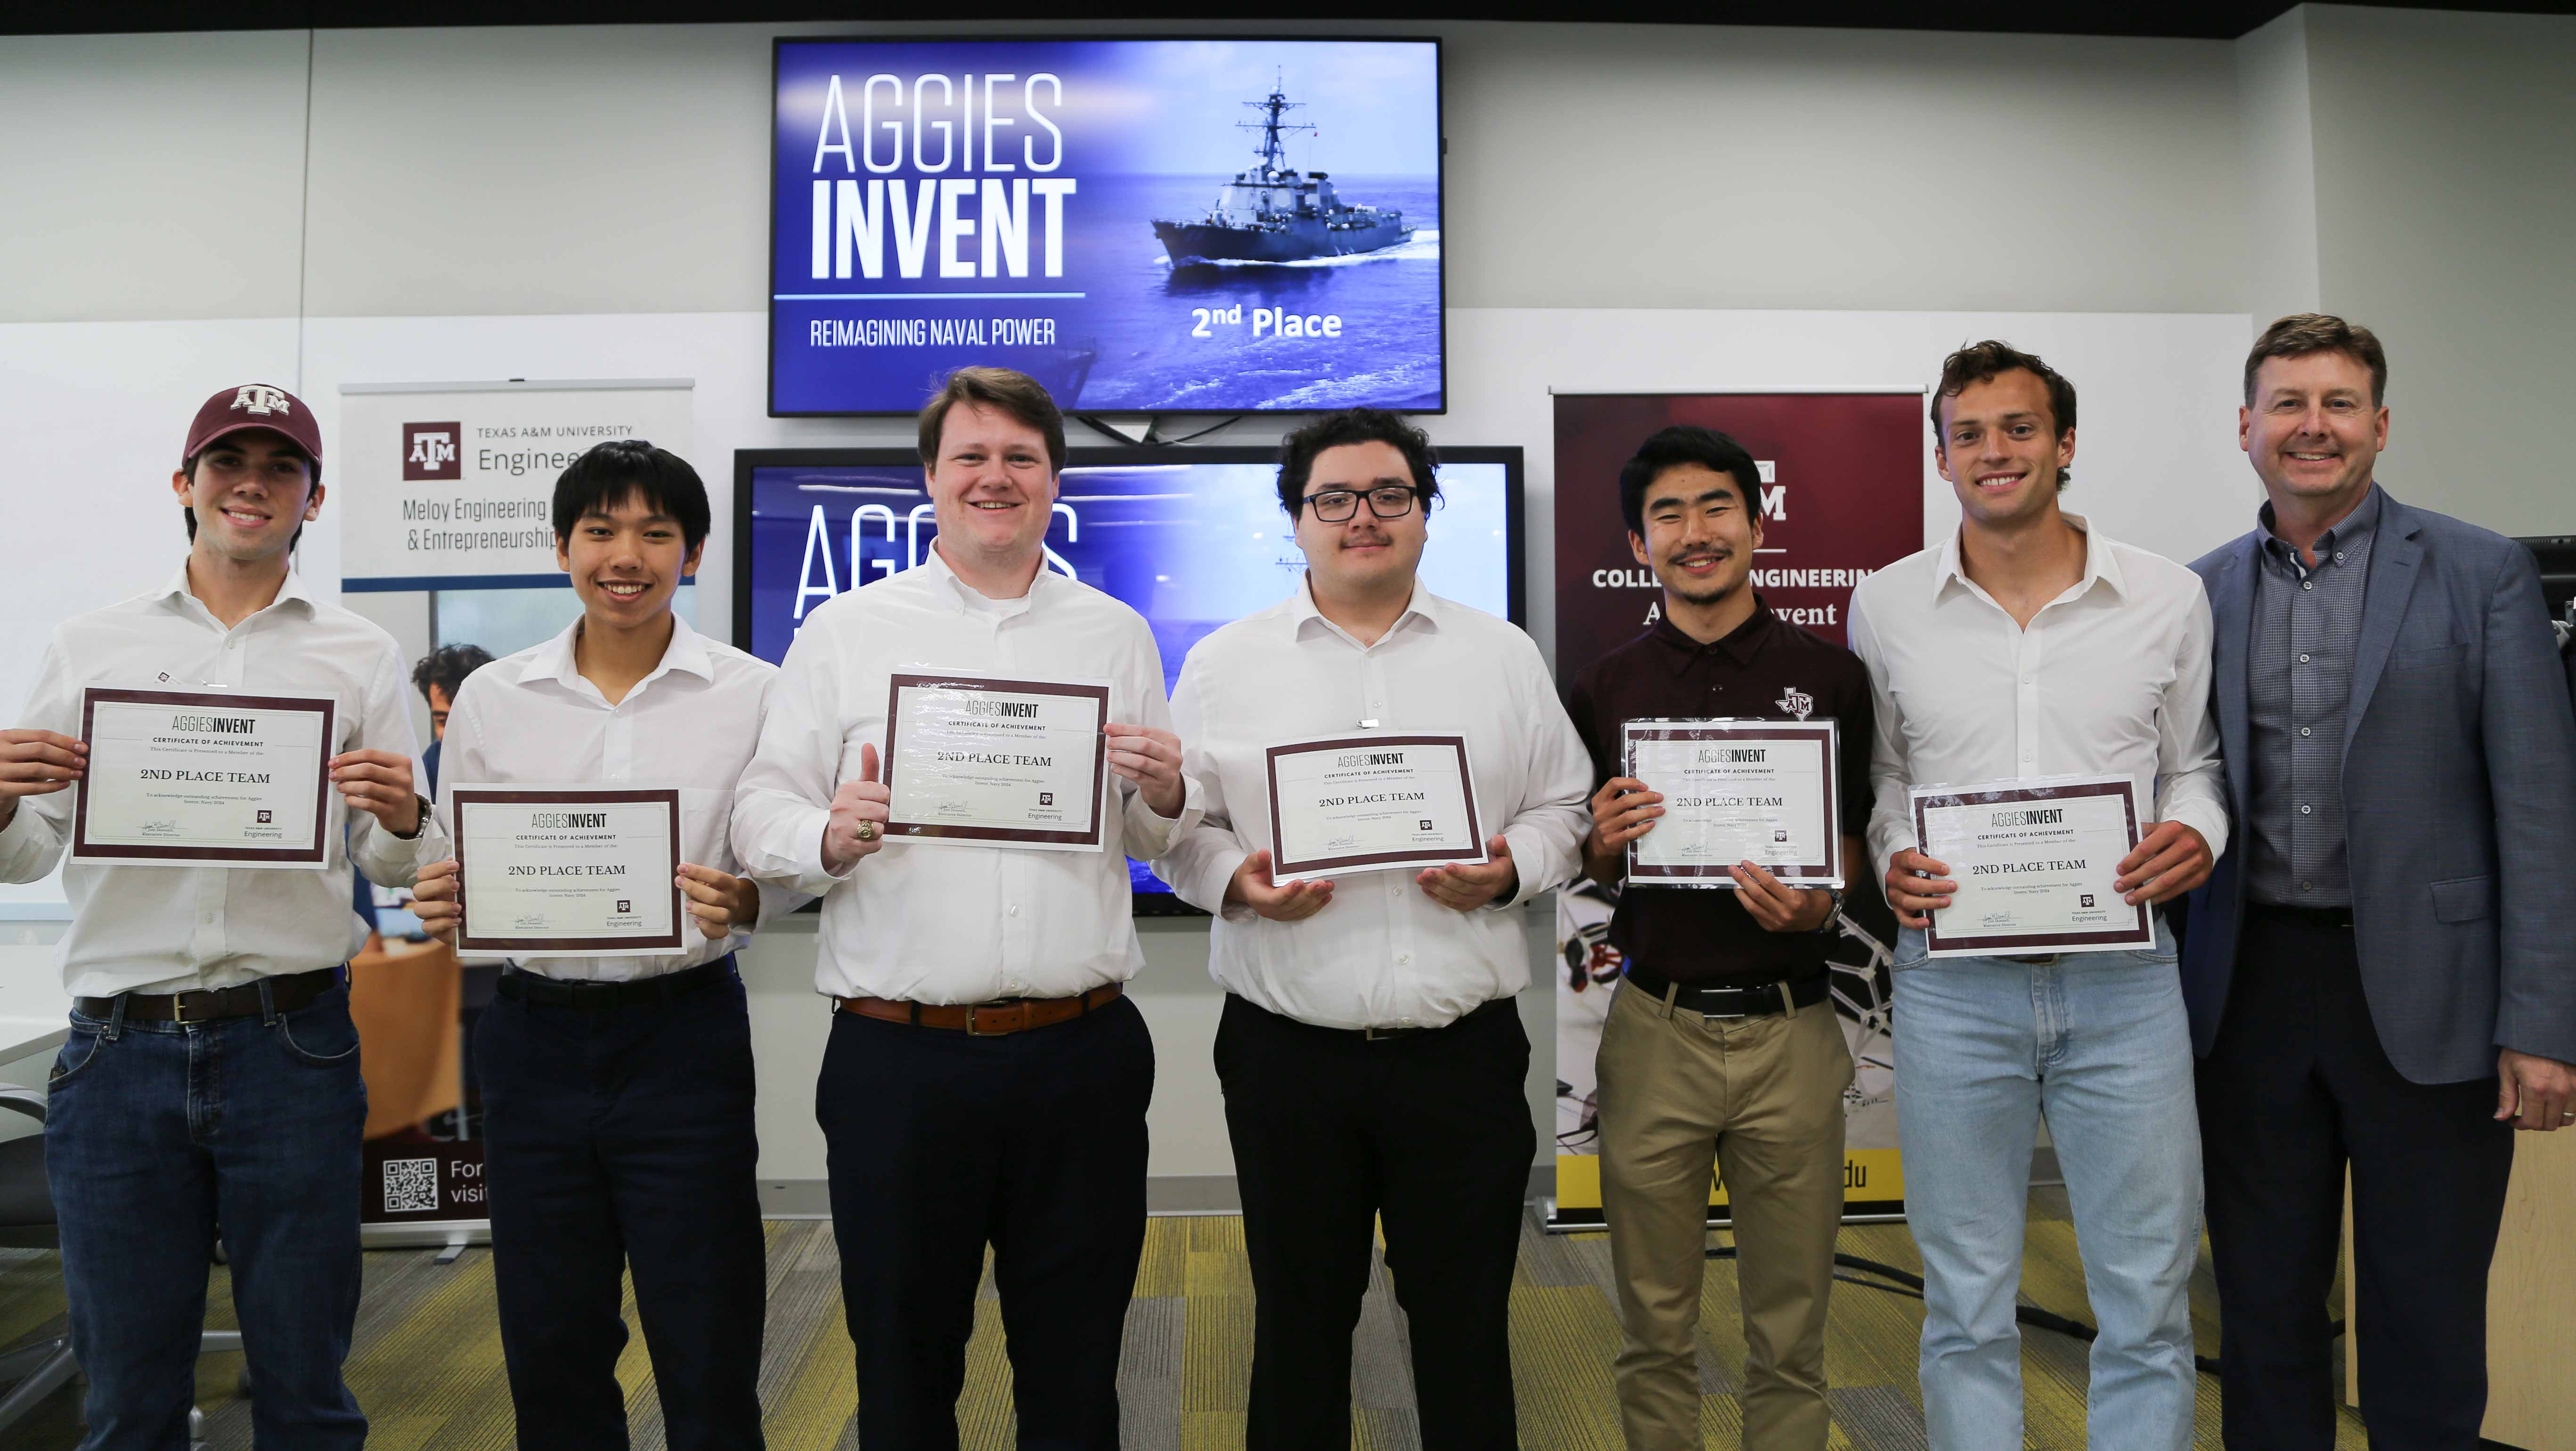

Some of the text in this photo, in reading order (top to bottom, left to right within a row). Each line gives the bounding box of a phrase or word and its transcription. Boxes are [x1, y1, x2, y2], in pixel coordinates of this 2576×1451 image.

[813, 73, 1062, 173] AGGIES
[812, 178, 1076, 279] INVENT
[1191, 303, 1342, 338] 2nd Place
[810, 318, 1055, 347] REIMAGINING NAVAL POWER
[477, 425, 633, 438] TEXAS A&M UNIVERSITY
[479, 448, 577, 476] Enginee
[403, 499, 546, 523] Meloy Engineering
[408, 530, 418, 550] &
[966, 700, 1037, 718] AGGIESINVENT
[172, 715, 255, 734] AGGIESINVENT
[937, 751, 1051, 766] 2ND PLACE TEAM
[1338, 753, 1403, 767] AGGIESINVENT
[140, 769, 270, 783] 2ND PLACE TEAM
[1319, 791, 1425, 806] 2ND PLACE TEAM
[1677, 797, 1782, 806] 2ND PLACE TEAM
[531, 813, 606, 828] AGGIESINVENT
[1028, 812, 1062, 820] Engineering
[1991, 809, 2063, 827] AGGIESINVENT
[2029, 829, 2074, 837] ACHIEVEMENT
[508, 865, 625, 875] 2ND PLACE TEAM
[1973, 859, 2086, 874] 2ND PLACE TEAM
[2071, 914, 2107, 922] Engineering
[451, 1161, 483, 1178] For
